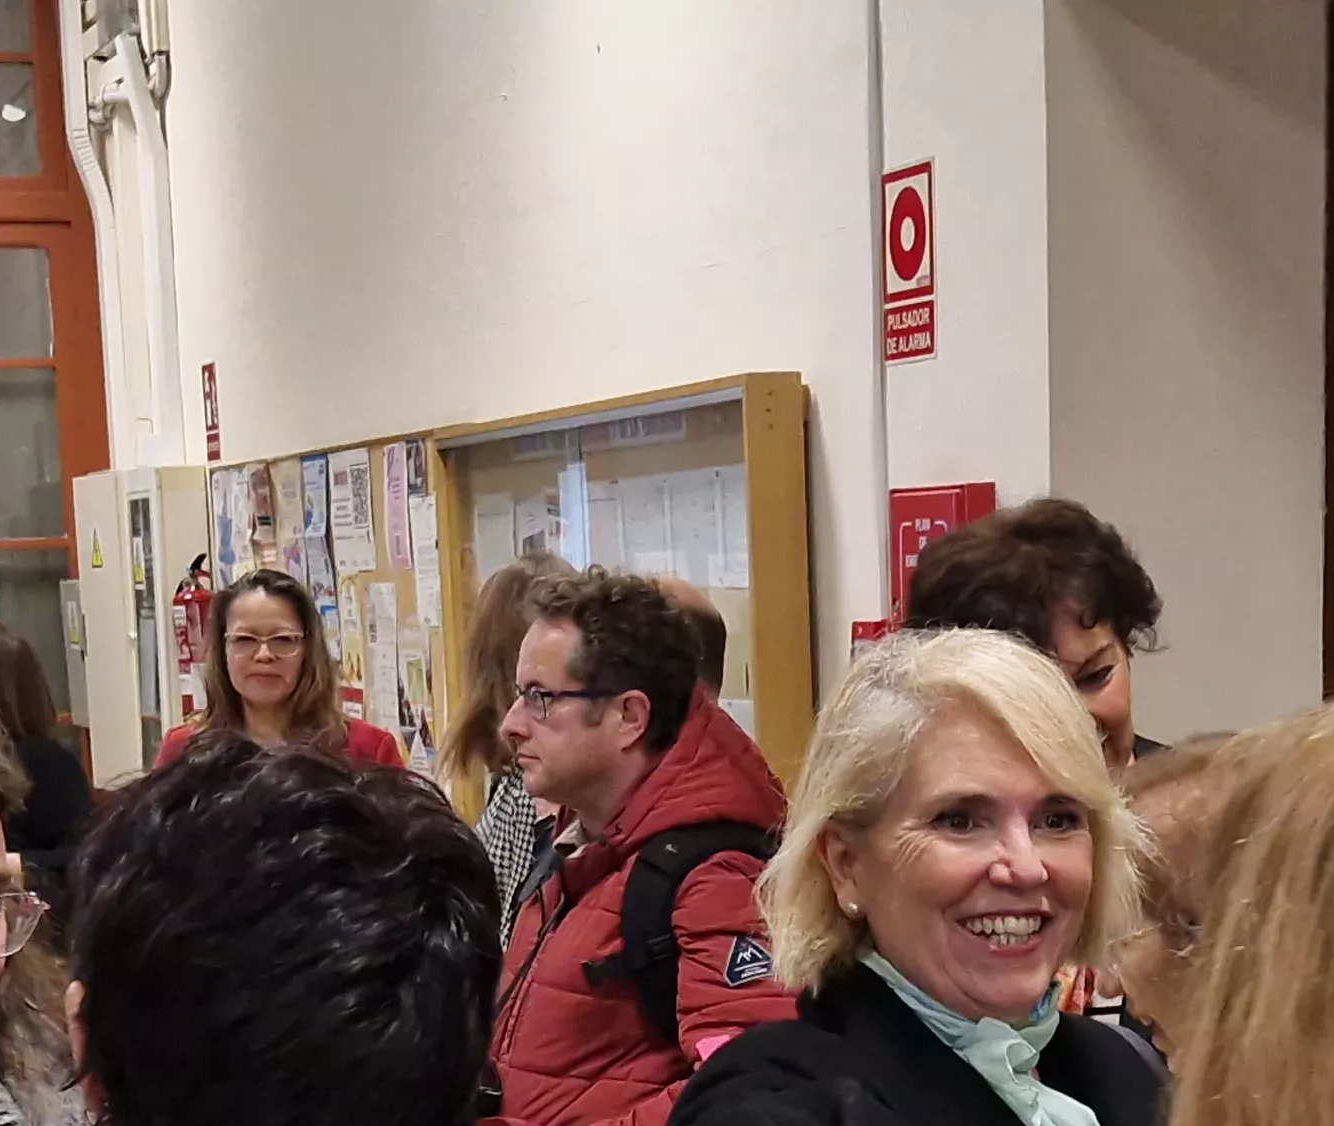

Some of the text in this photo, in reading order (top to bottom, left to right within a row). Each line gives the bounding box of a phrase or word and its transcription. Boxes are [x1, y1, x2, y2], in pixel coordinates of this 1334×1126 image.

[887, 307, 930, 331] PULSADOR
[887, 331, 931, 354] DE ALARMA
